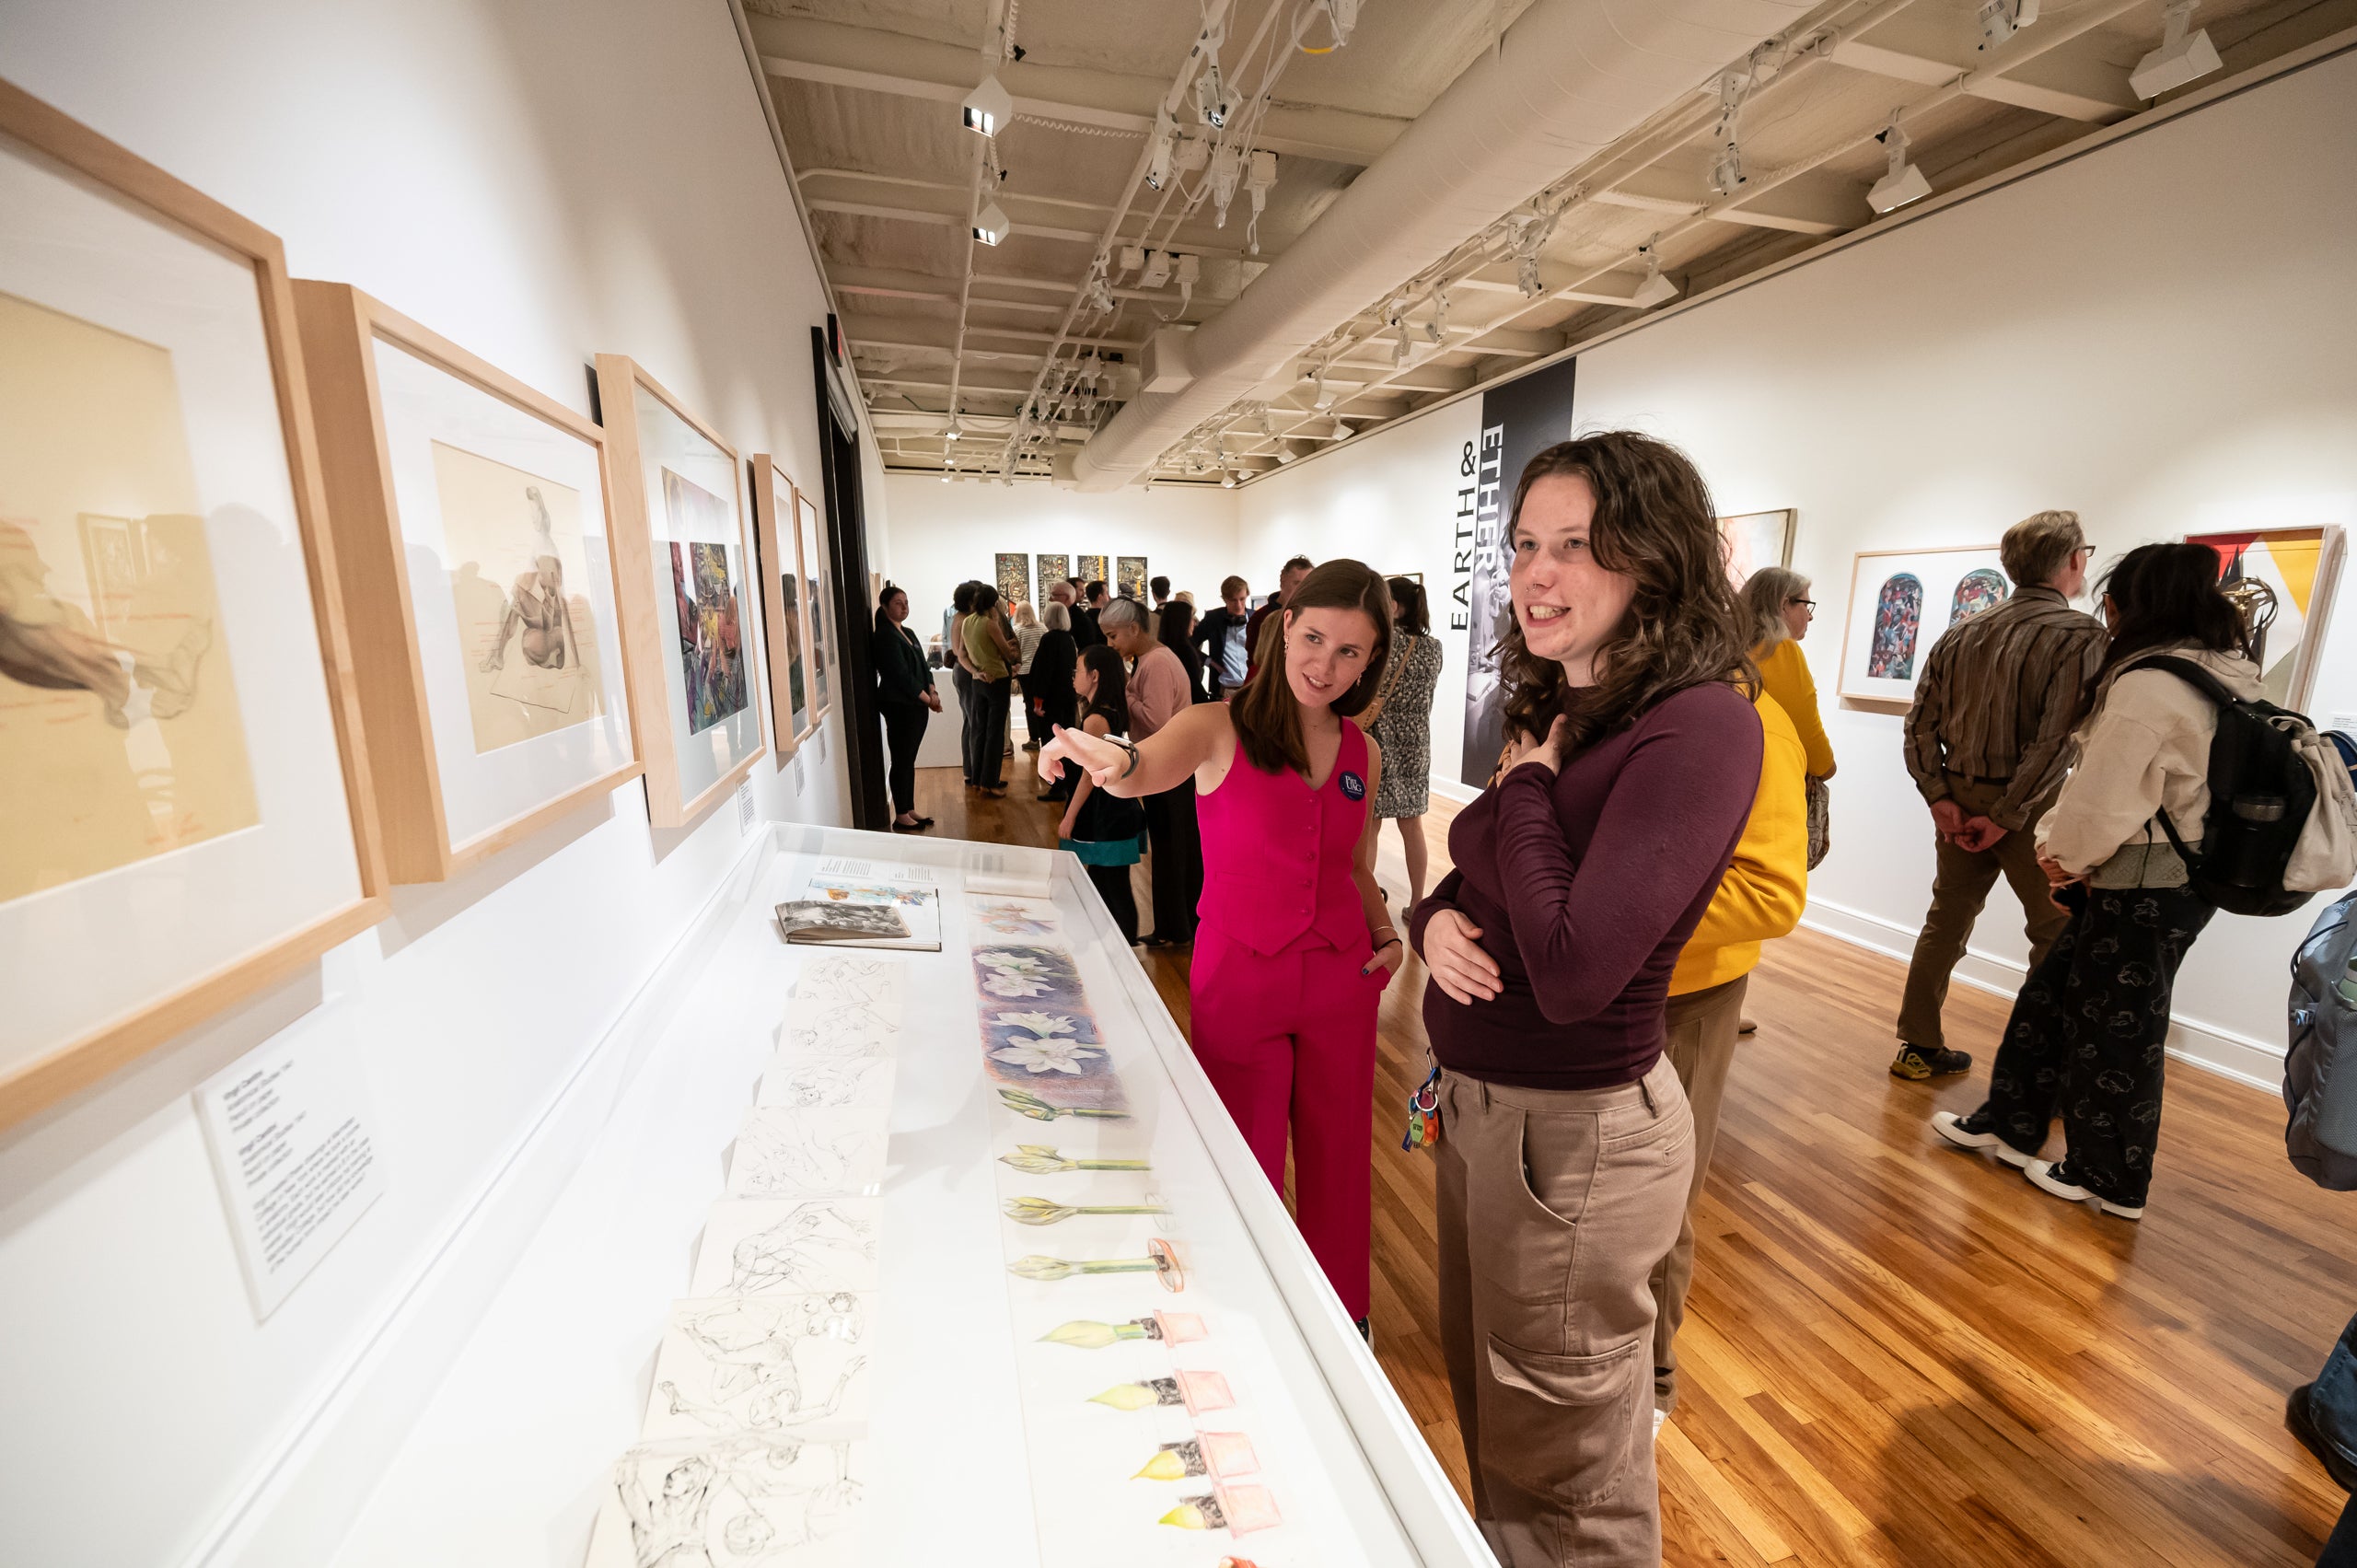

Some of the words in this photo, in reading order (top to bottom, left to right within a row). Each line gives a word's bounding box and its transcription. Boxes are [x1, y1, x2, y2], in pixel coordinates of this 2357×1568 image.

[1461, 440, 1477, 477] &
[1476, 424, 1504, 574] ETHER
[1451, 488, 1475, 631] EARTH
